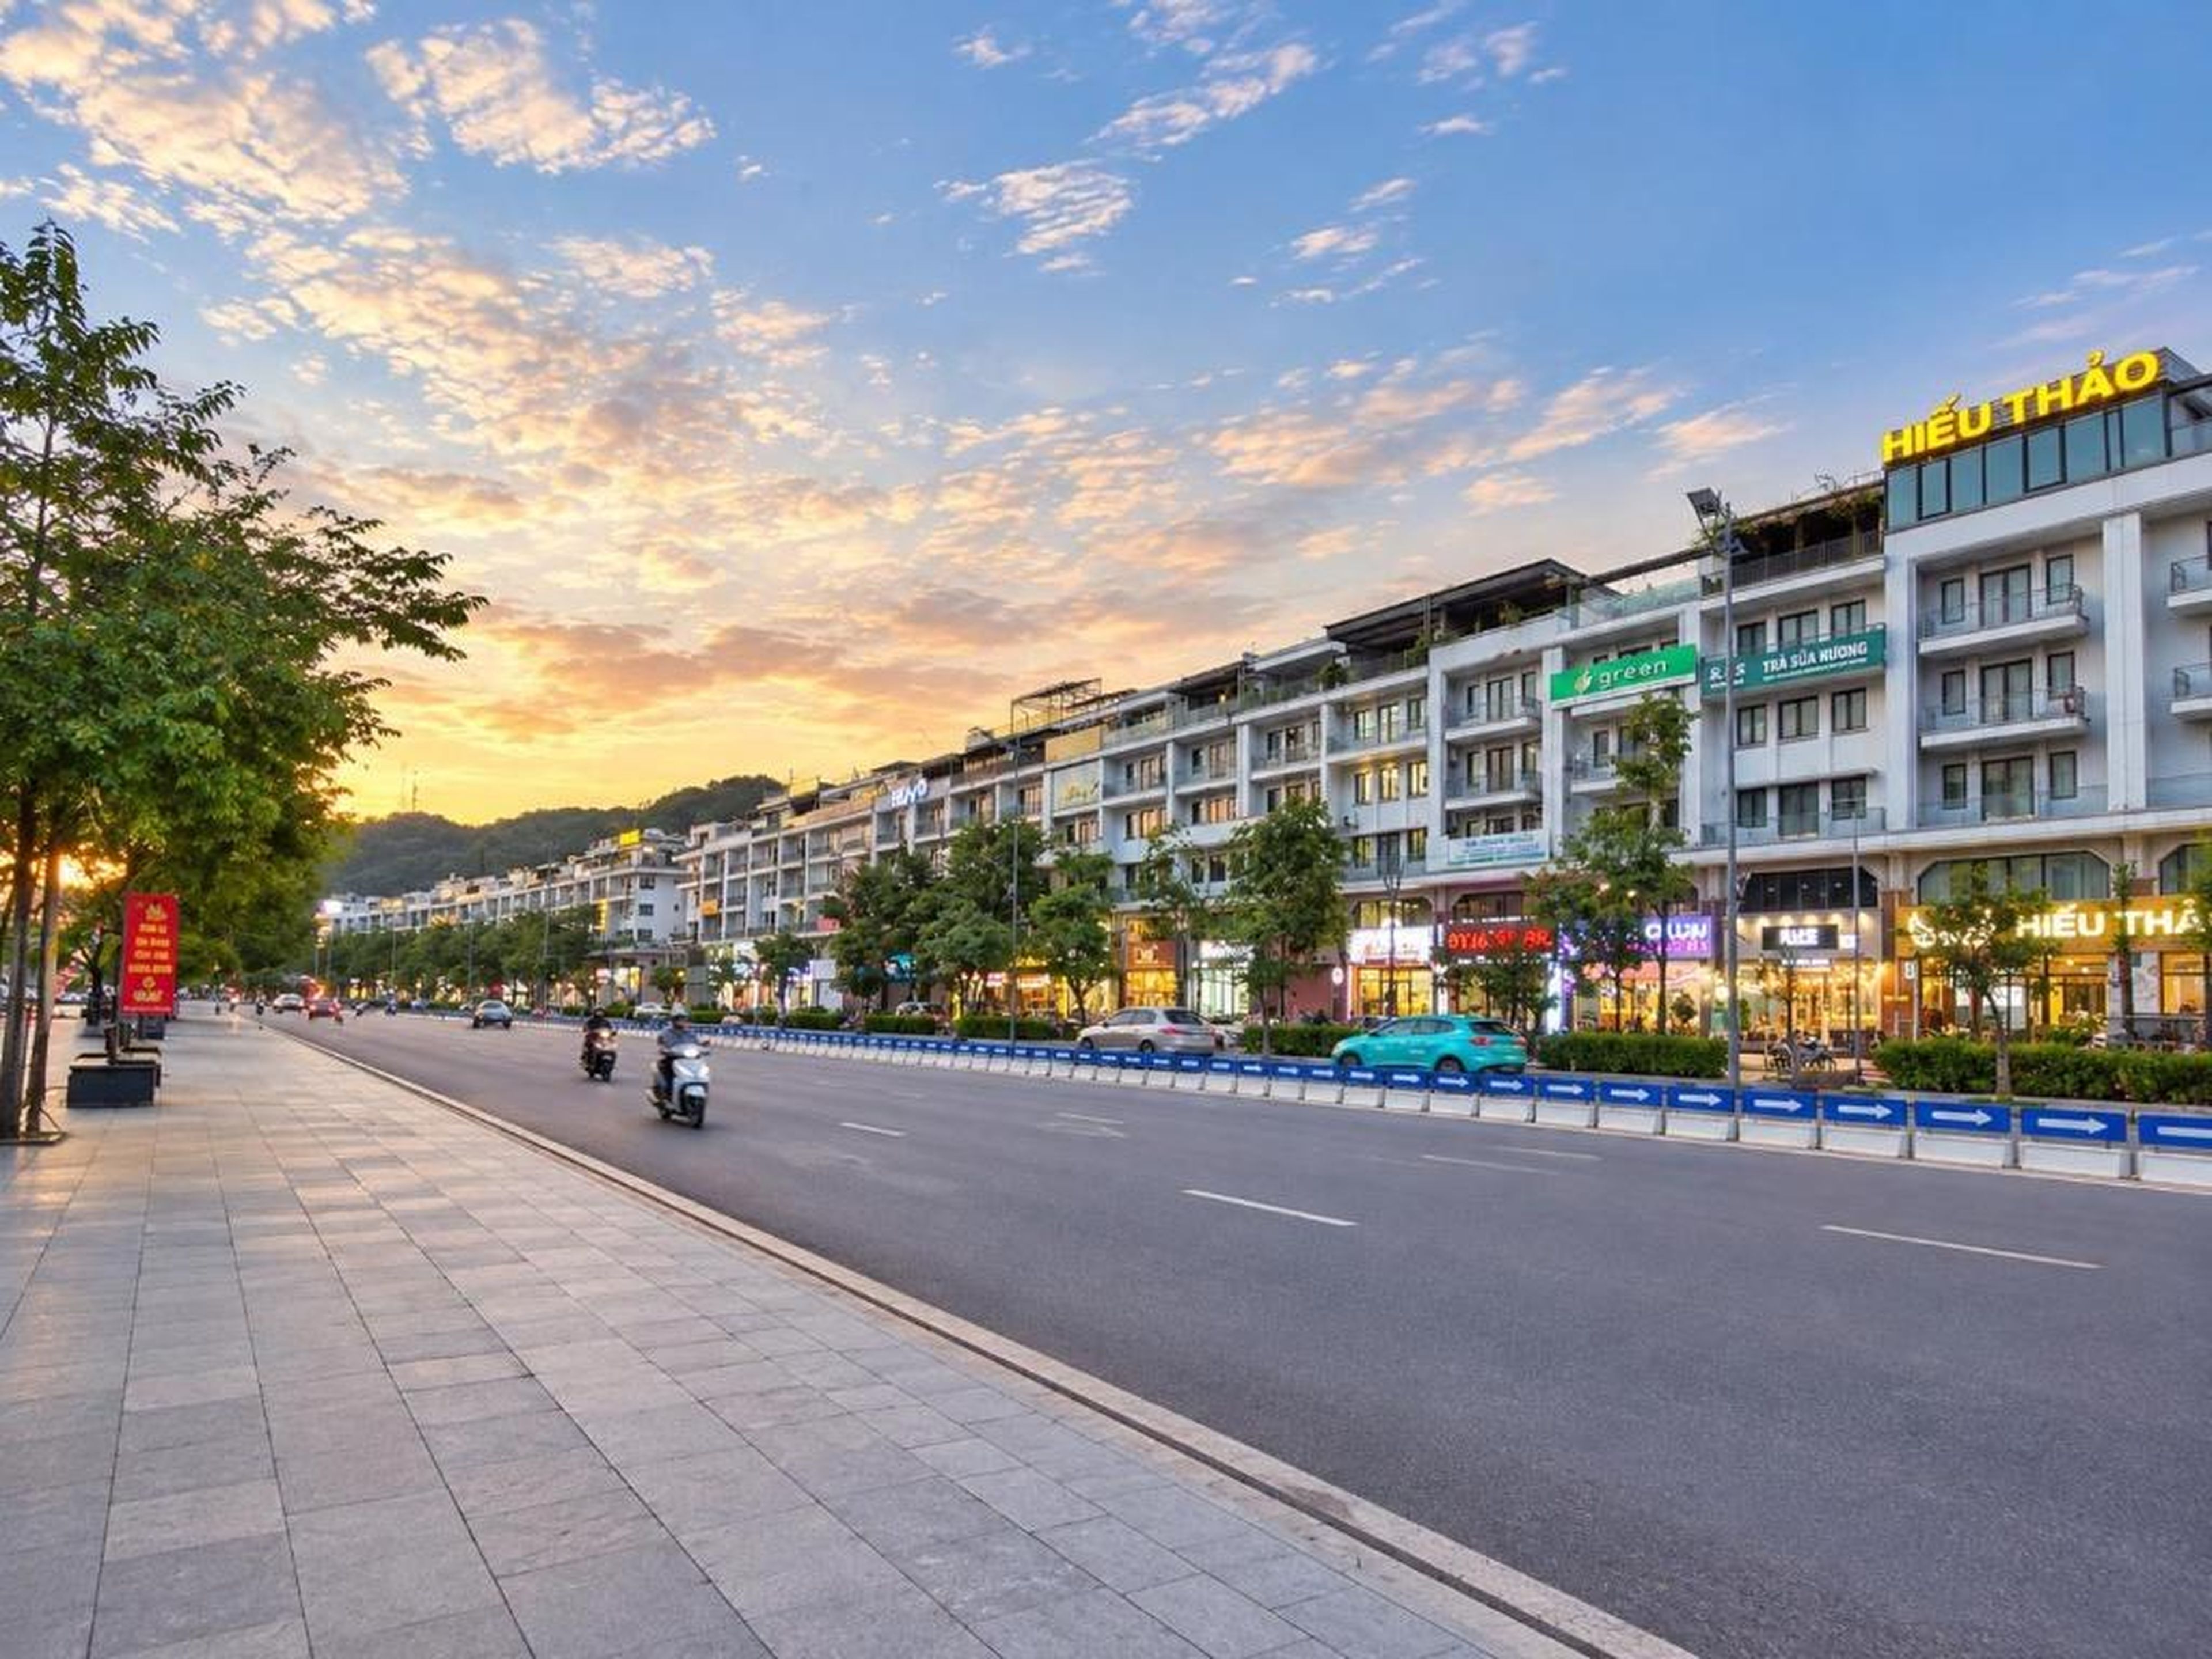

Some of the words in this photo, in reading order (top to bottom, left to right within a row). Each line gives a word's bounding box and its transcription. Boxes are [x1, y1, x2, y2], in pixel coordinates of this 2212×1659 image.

[1882, 393, 1993, 463] HIẾU
[2003, 350, 2160, 424] THẢO
[1599, 661, 1667, 688] green
[2015, 902, 2105, 938] HIẾU
[2115, 898, 2212, 936] THẢ
